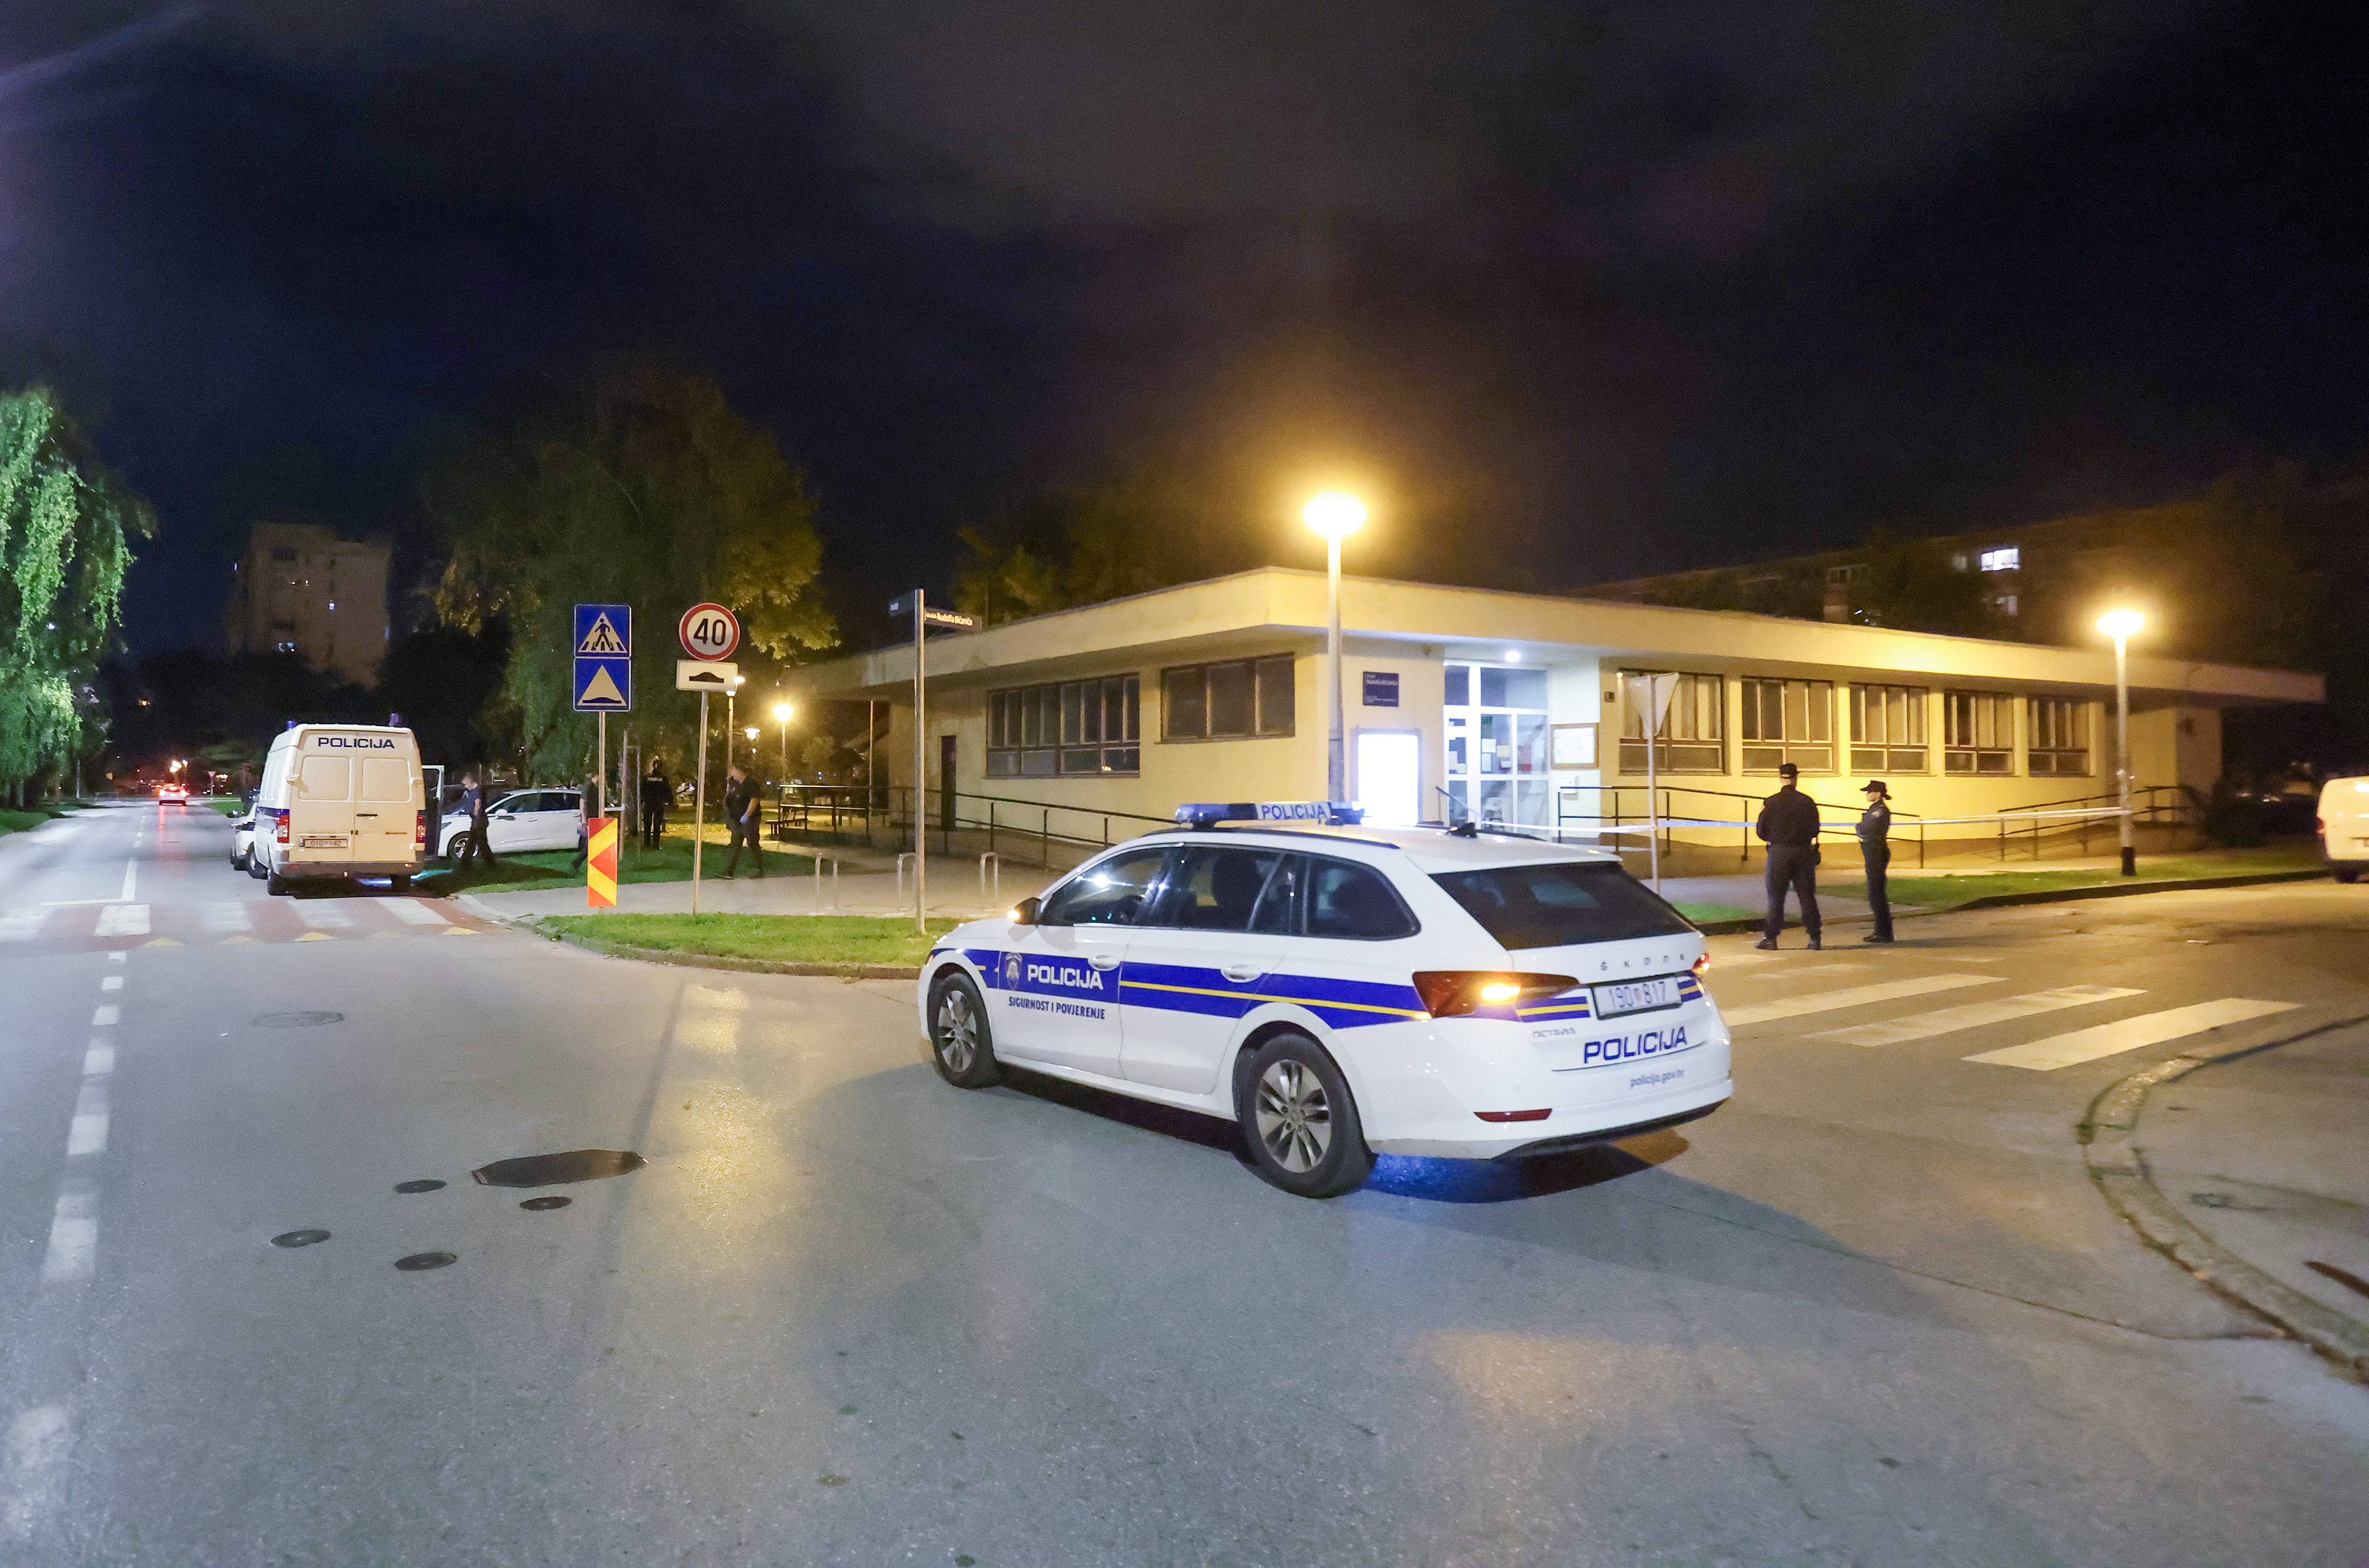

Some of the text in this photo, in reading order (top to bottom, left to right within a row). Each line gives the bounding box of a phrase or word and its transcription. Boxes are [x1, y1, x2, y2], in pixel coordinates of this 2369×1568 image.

[694, 618, 726, 646] 40
[318, 737, 394, 749] POLICIJA
[1261, 804, 1328, 820] POLICIJA
[1028, 964, 1104, 990] POLICIJA
[1643, 981, 1665, 1004] 817
[1009, 996, 1105, 1020] SIGURNOST I POVJERENJE
[1584, 1026, 1687, 1063] POLICIJA
